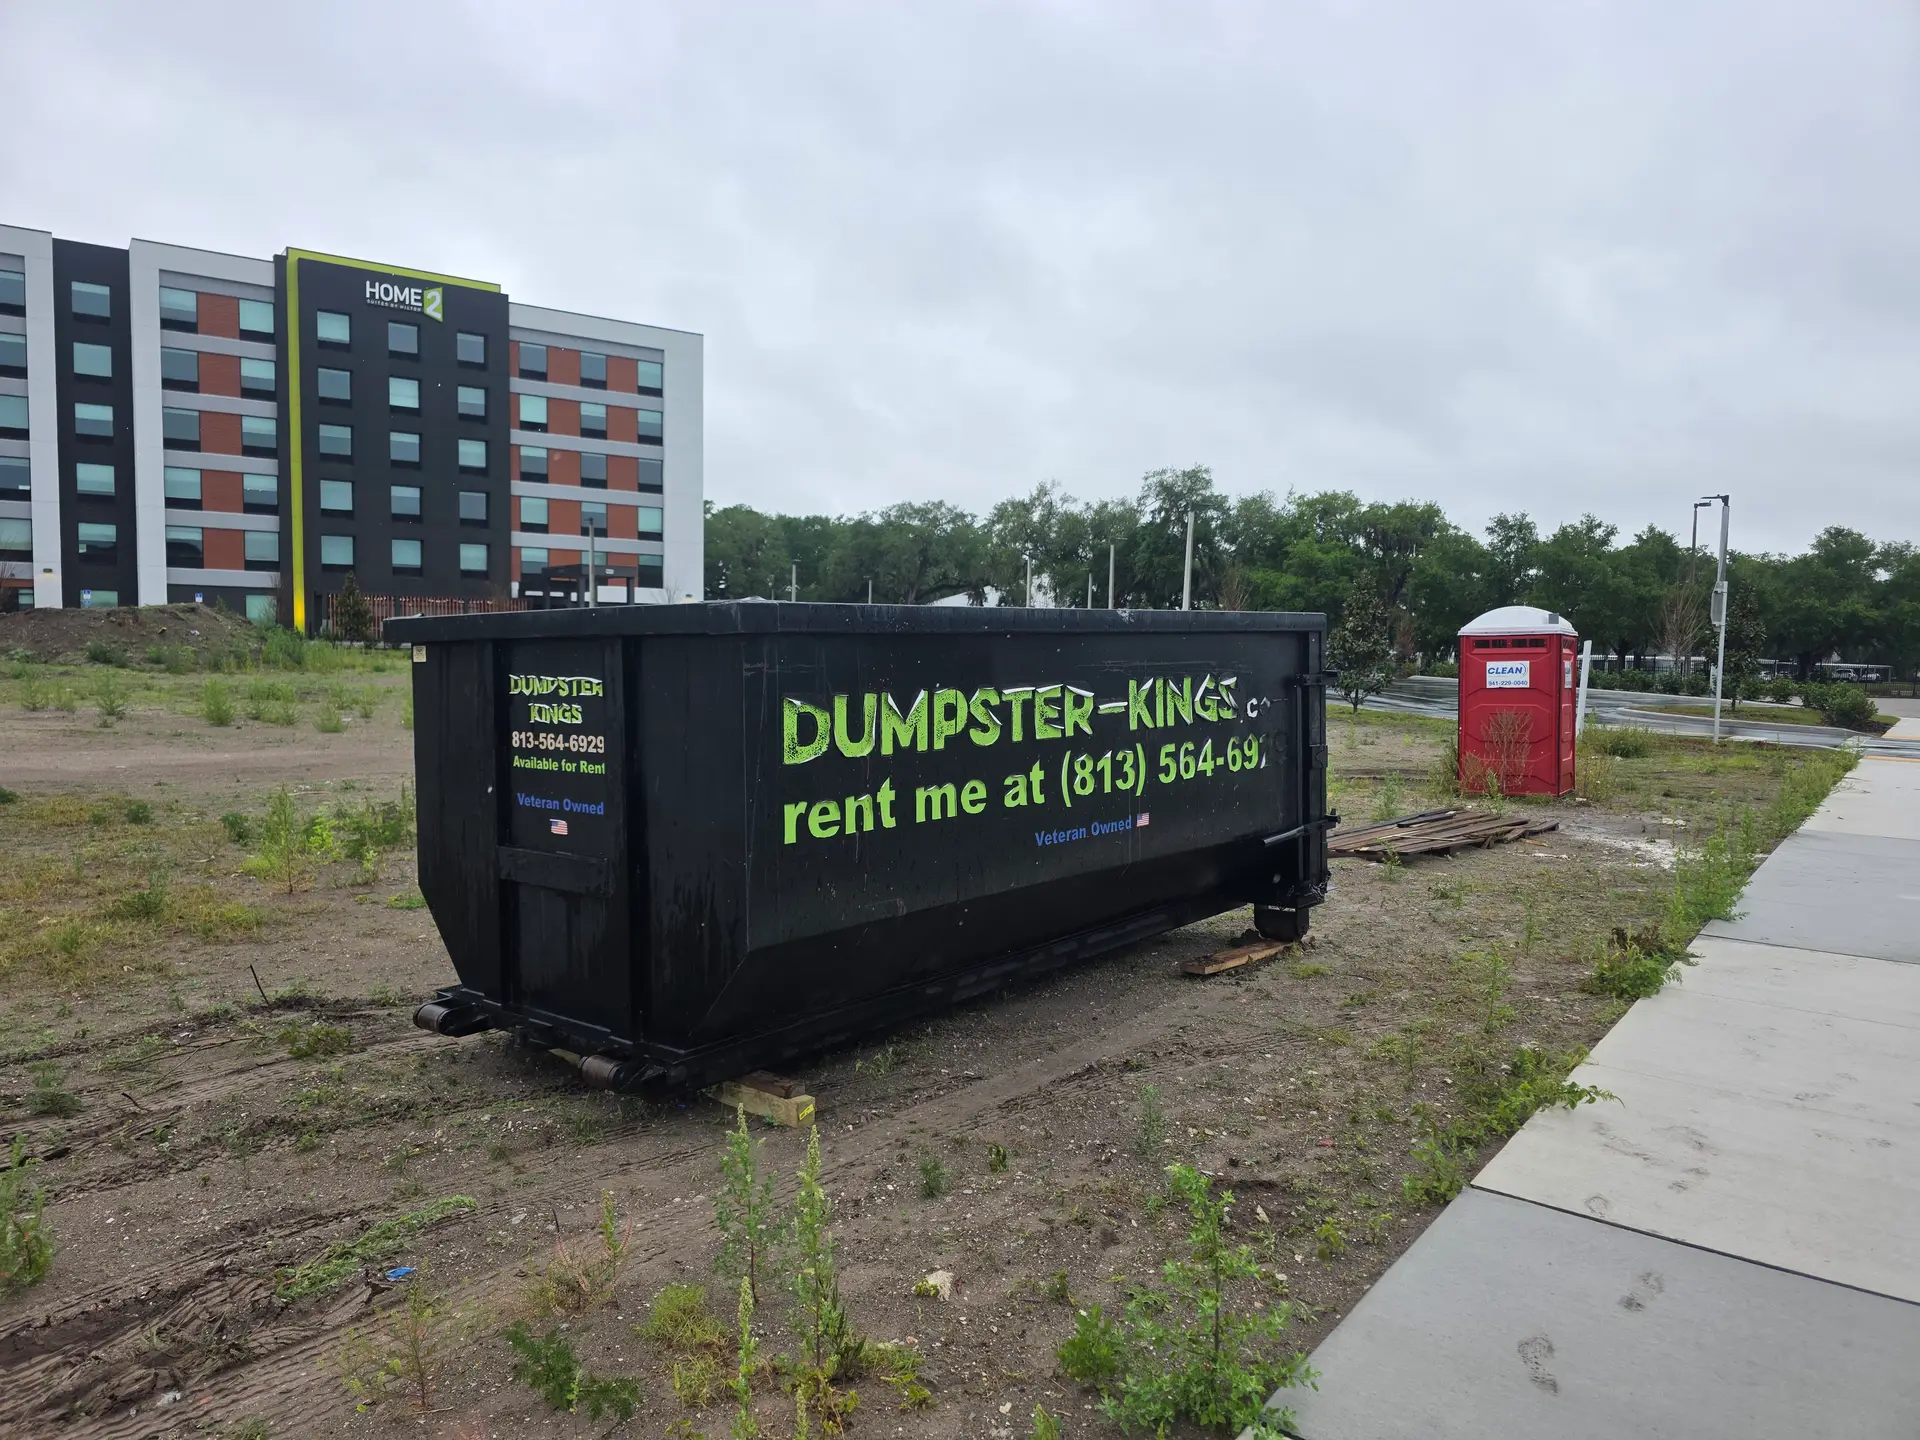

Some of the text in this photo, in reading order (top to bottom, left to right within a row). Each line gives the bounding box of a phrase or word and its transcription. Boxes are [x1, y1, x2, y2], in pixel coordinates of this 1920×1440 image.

[365, 280, 441, 319] HOME 2
[1488, 666, 1522, 674] CLEAN
[509, 674, 603, 697] DUMPSTER
[528, 702, 583, 724] KINGS
[511, 730, 605, 754] 813-564-6929
[513, 755, 606, 775] Available for Rent
[517, 792, 604, 816] Veteran Owned
[784, 779, 897, 844] rent
[915, 779, 988, 824] me
[1004, 758, 1046, 808] at
[1061, 742, 1147, 807] (813)
[1035, 814, 1132, 847] Veteran Owned
